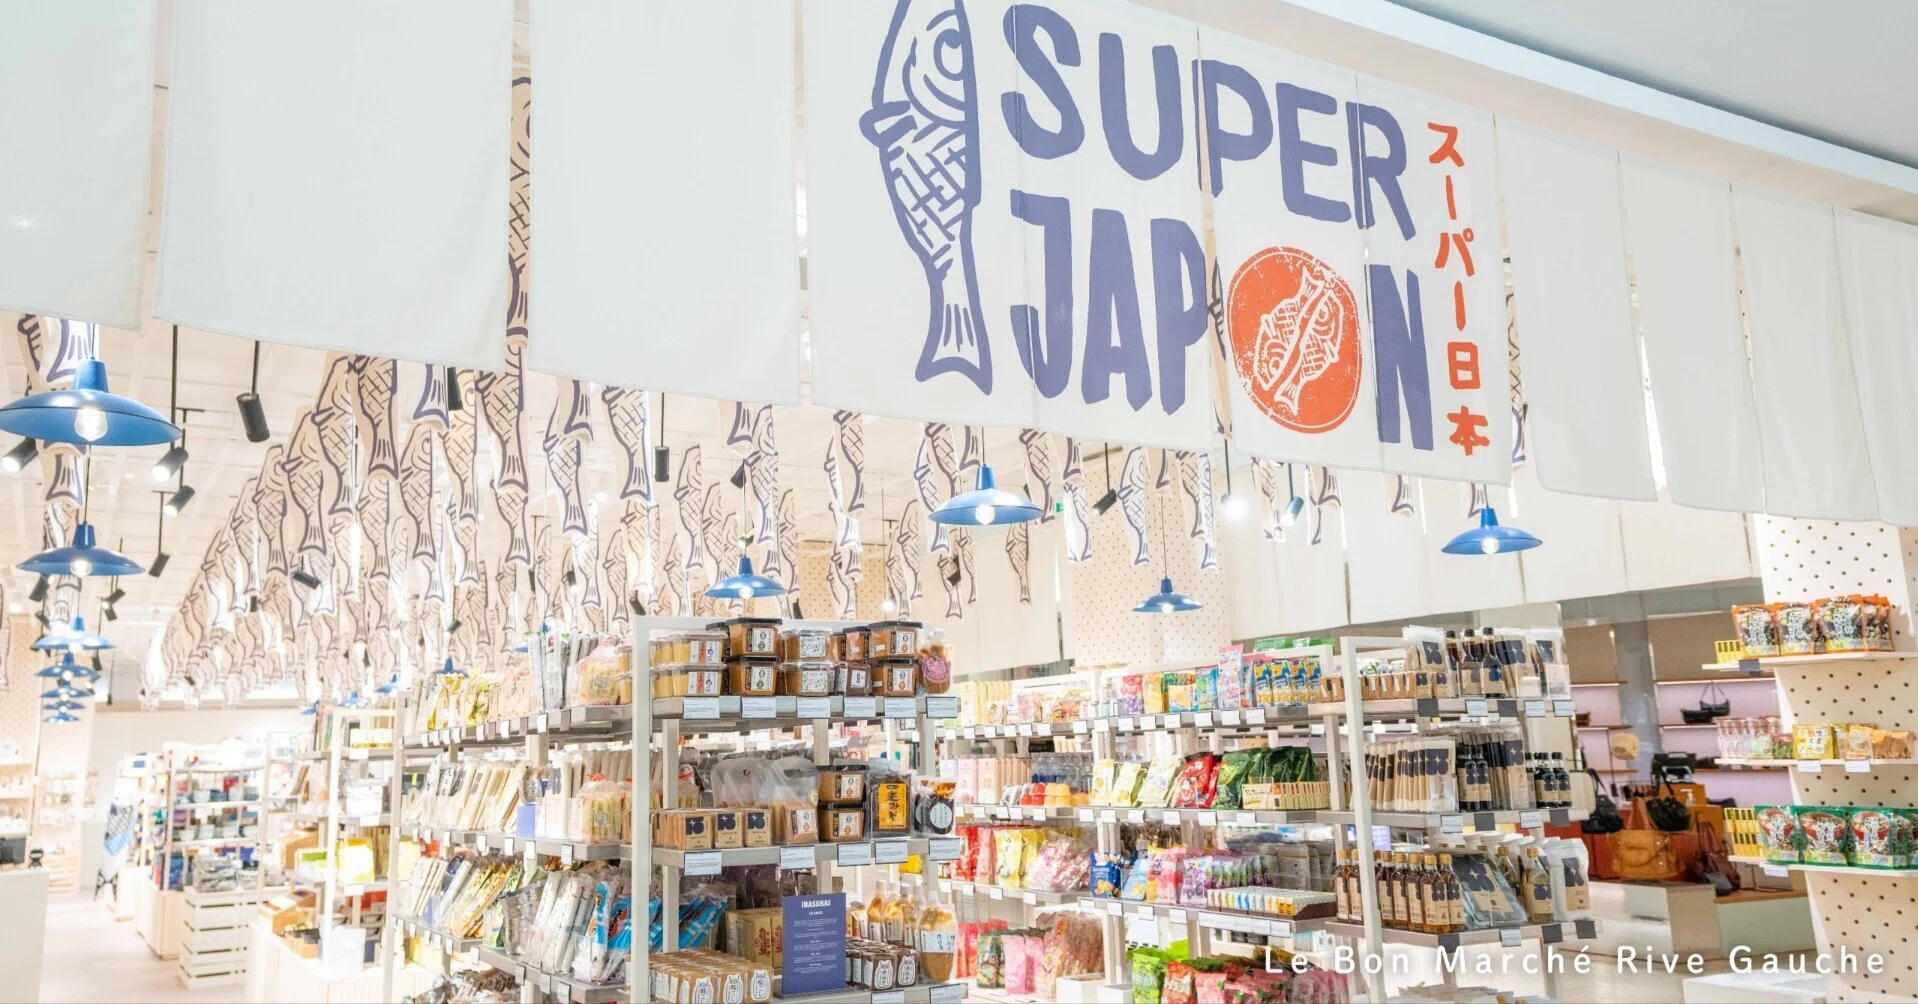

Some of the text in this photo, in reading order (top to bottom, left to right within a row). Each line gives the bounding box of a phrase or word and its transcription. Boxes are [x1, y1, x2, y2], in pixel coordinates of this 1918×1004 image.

[1001, 4, 1416, 240] SUPER
[1426, 121, 1491, 456] スーパー日本
